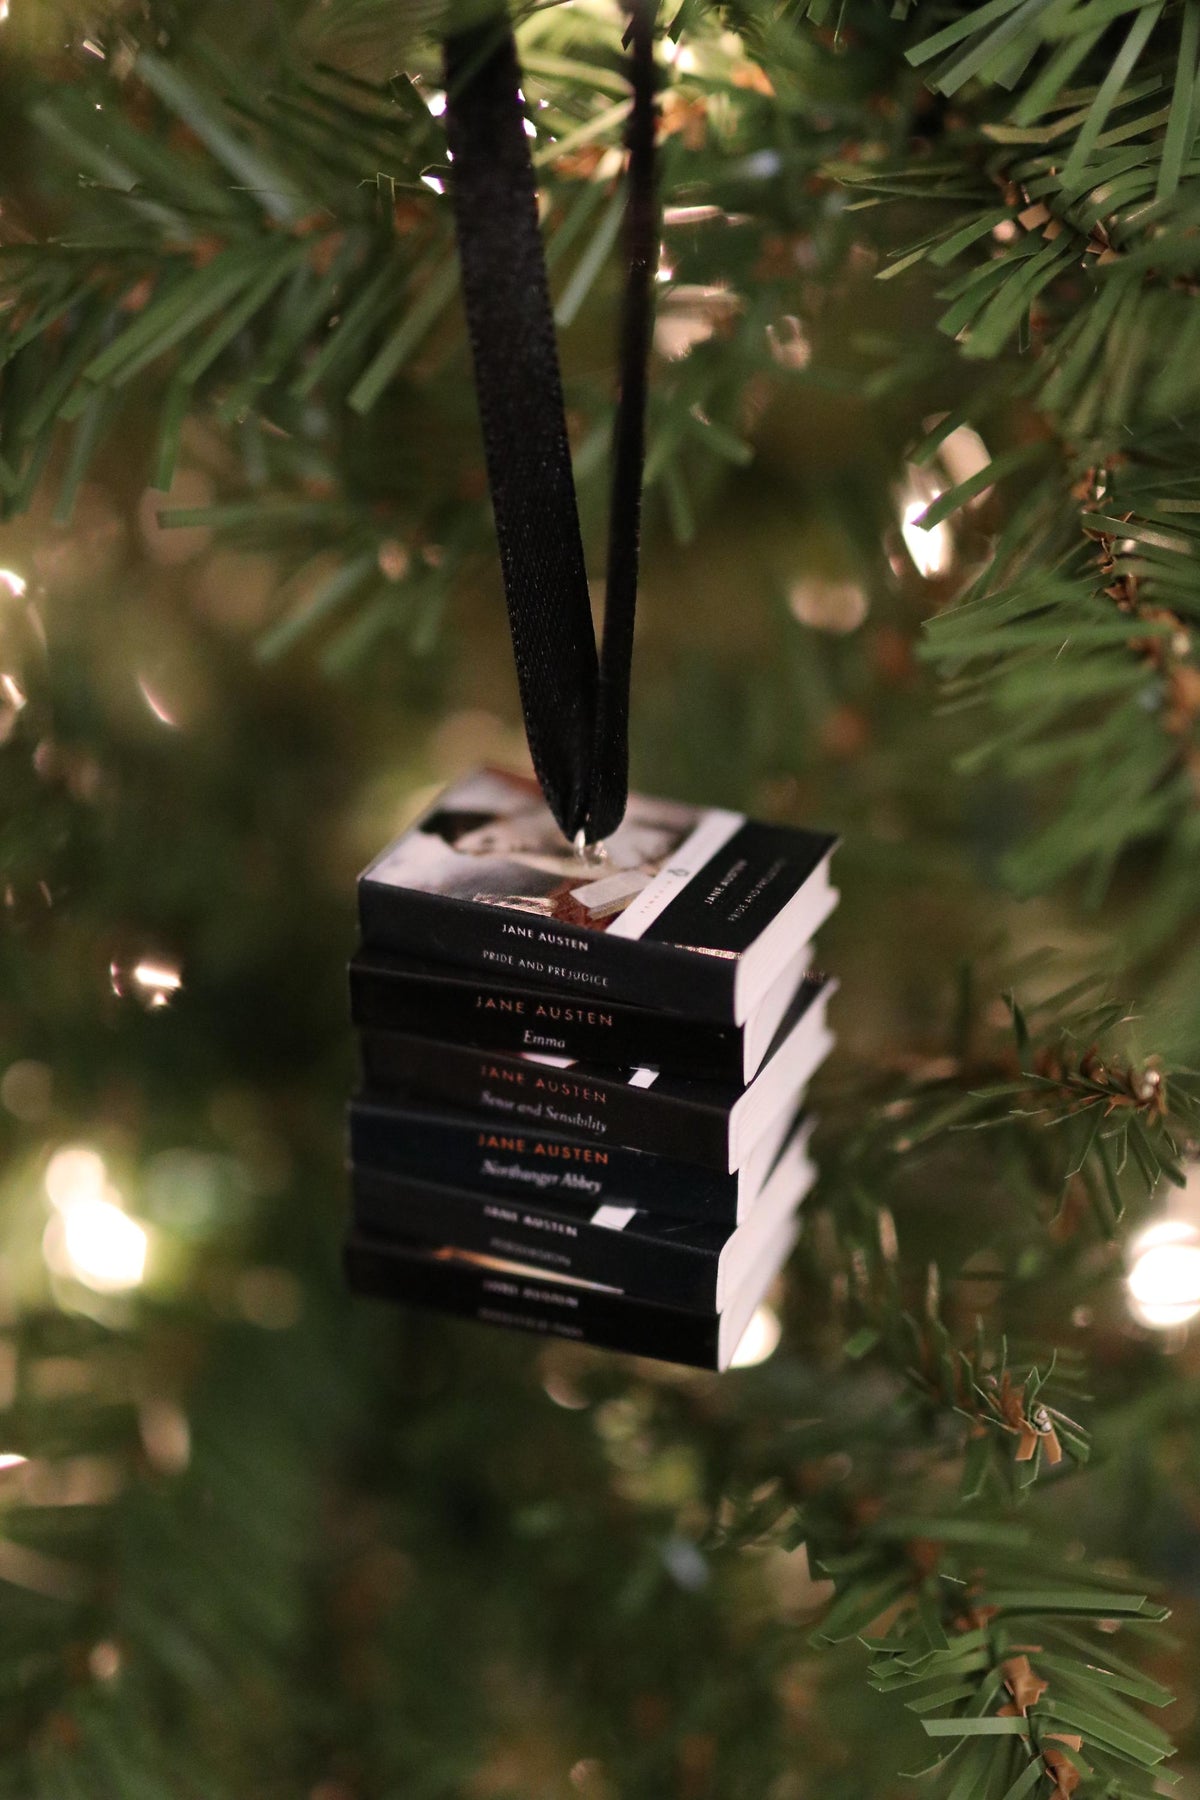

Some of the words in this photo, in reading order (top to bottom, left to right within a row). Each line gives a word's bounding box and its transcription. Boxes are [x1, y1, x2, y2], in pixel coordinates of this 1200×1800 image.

[704, 886, 725, 905] JANE
[501, 923, 534, 939] JANE
[537, 932, 589, 952] AUSTEN
[482, 949, 514, 966] PRIDE
[518, 958, 544, 972] AND
[547, 964, 609, 987] PREJUDICE
[475, 995, 525, 1015] JANE
[535, 1005, 614, 1027] AUSTEN
[522, 1029, 567, 1049] Emma
[480, 1065, 524, 1085] JANE
[534, 1077, 607, 1105] AUSTEN
[516, 1102, 543, 1117] and
[545, 1105, 608, 1136] Sensibility
[477, 1133, 526, 1154] JANE
[533, 1141, 609, 1166] AUSTEN
[522, 1213, 578, 1239] AUSTEN
